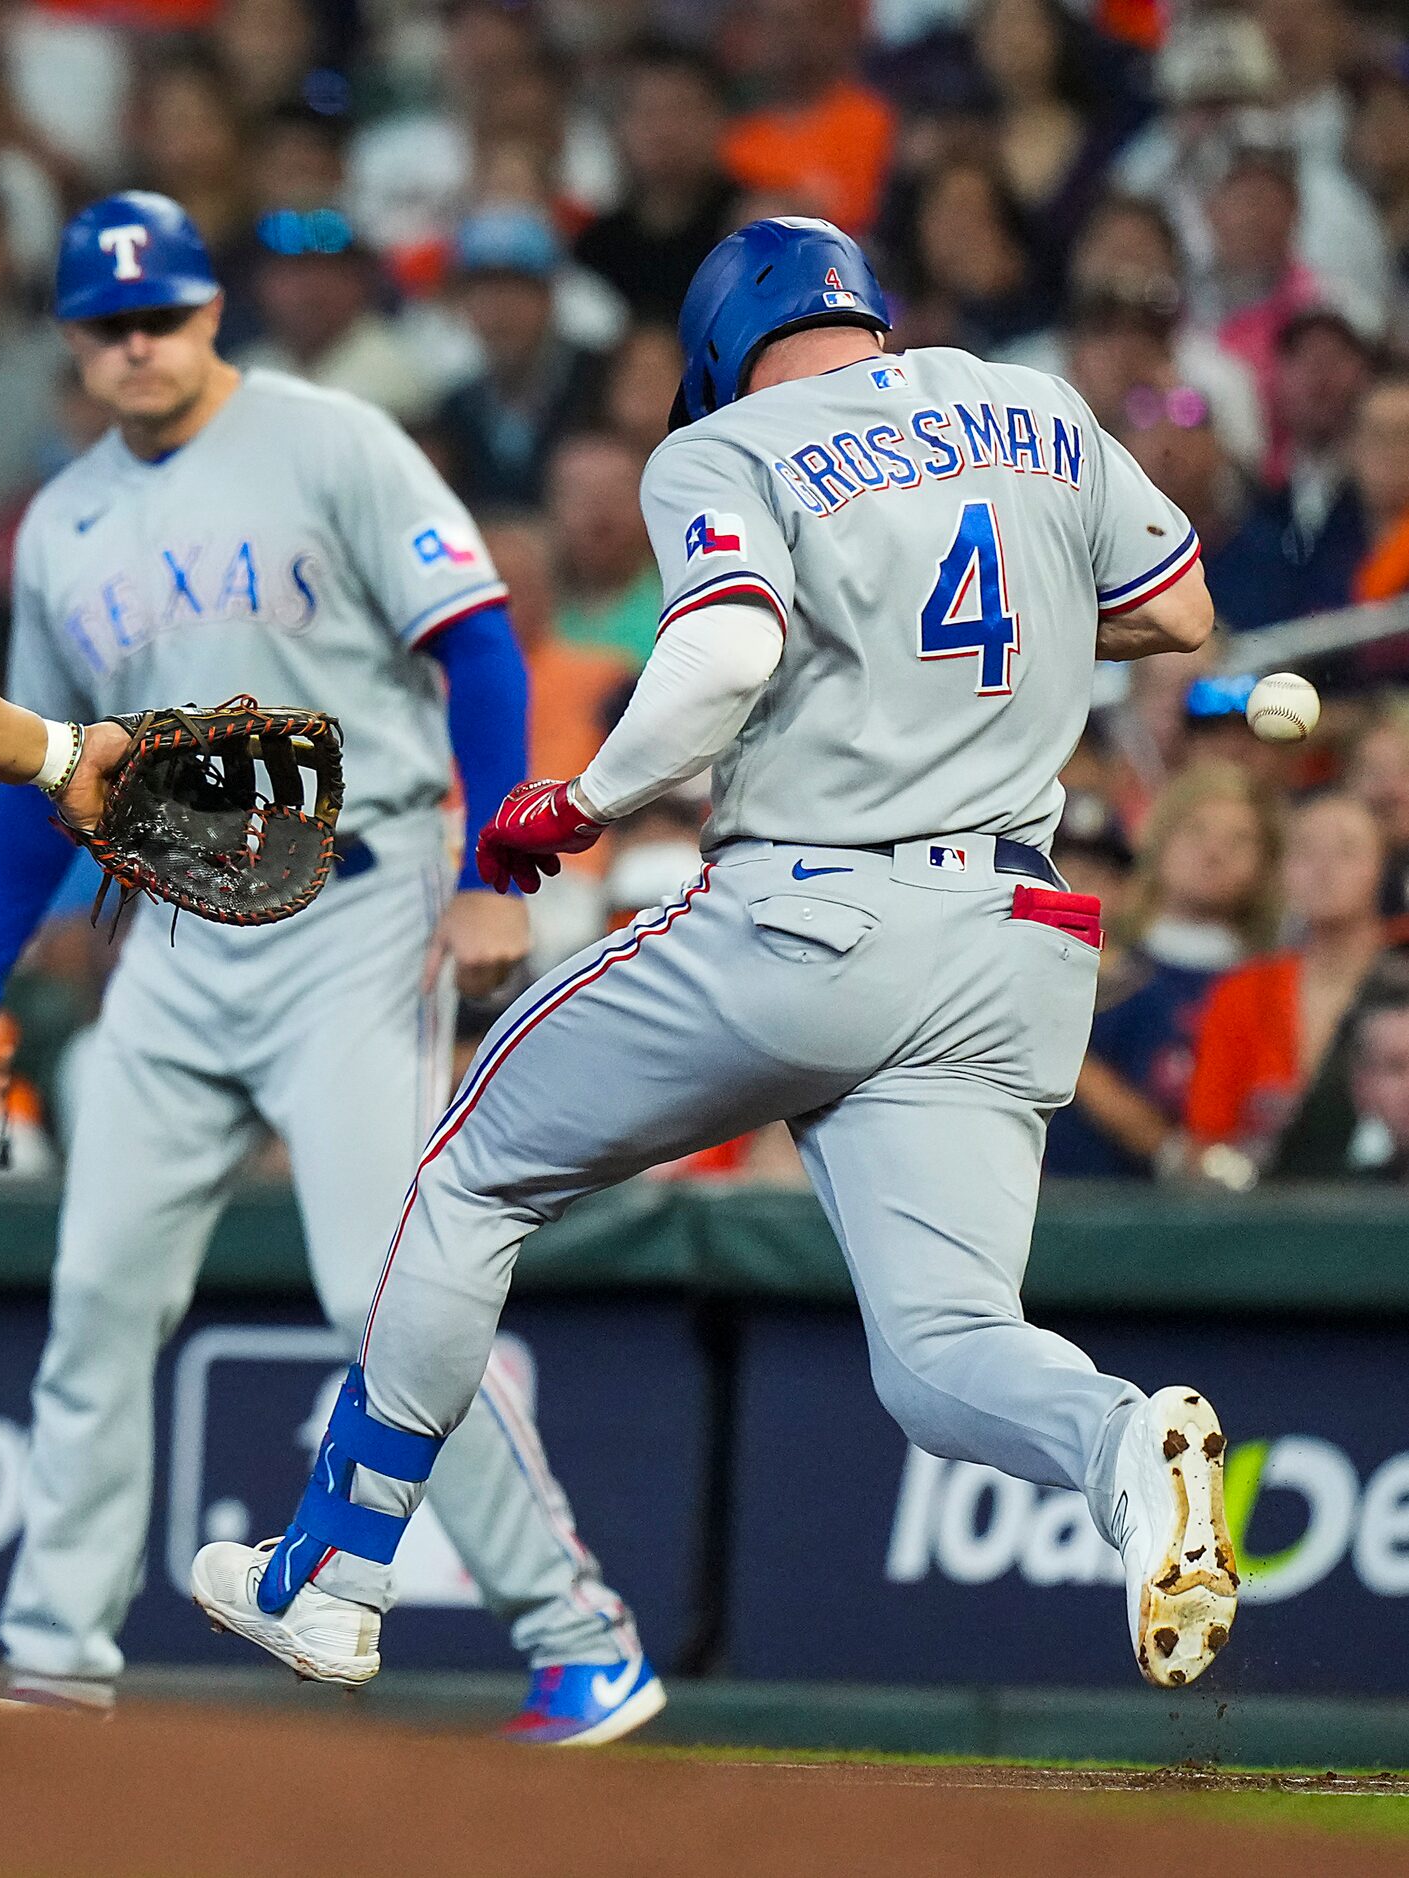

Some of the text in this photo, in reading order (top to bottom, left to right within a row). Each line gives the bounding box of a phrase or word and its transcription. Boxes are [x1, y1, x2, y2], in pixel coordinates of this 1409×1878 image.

[97, 224, 150, 282] T
[824, 267, 843, 290] 4
[774, 401, 1083, 517] GROSSMAN
[63, 536, 320, 676] TEXAS
[916, 498, 1020, 698] 4
